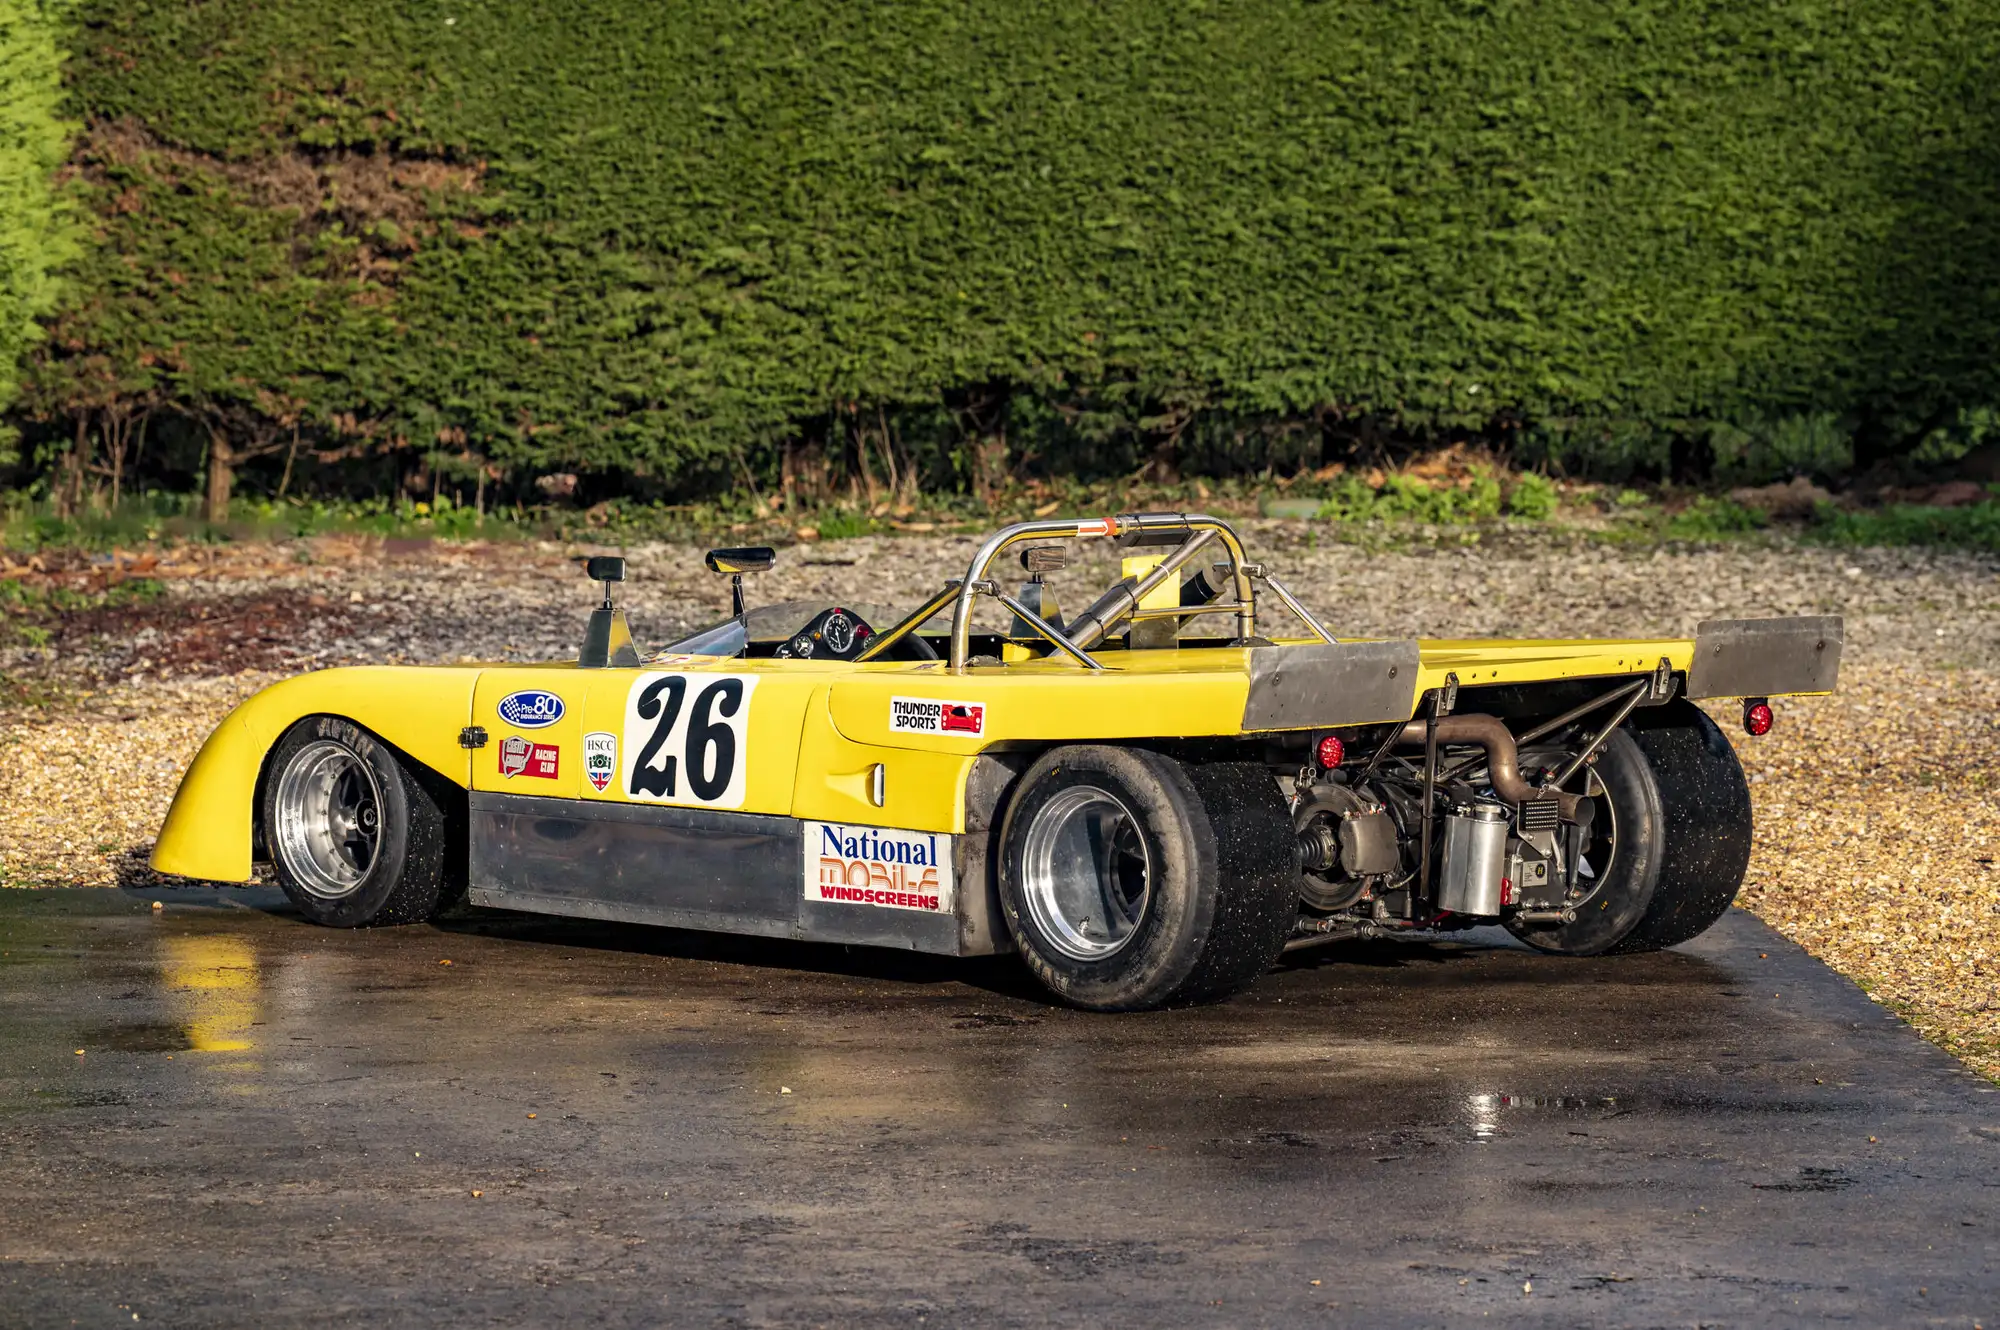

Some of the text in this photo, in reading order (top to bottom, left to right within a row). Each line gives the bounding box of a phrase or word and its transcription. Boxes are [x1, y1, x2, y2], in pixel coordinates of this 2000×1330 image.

[521, 695, 556, 715] Pre-80
[893, 702, 940, 717] THUNDER
[896, 716, 936, 730] SPORTS
[587, 739, 614, 751] HSCC
[630, 675, 743, 801] 26
[535, 749, 557, 762] RACING
[540, 761, 556, 774] CLUB
[820, 825, 938, 867] National
[820, 885, 940, 910] WINDSCREENS
